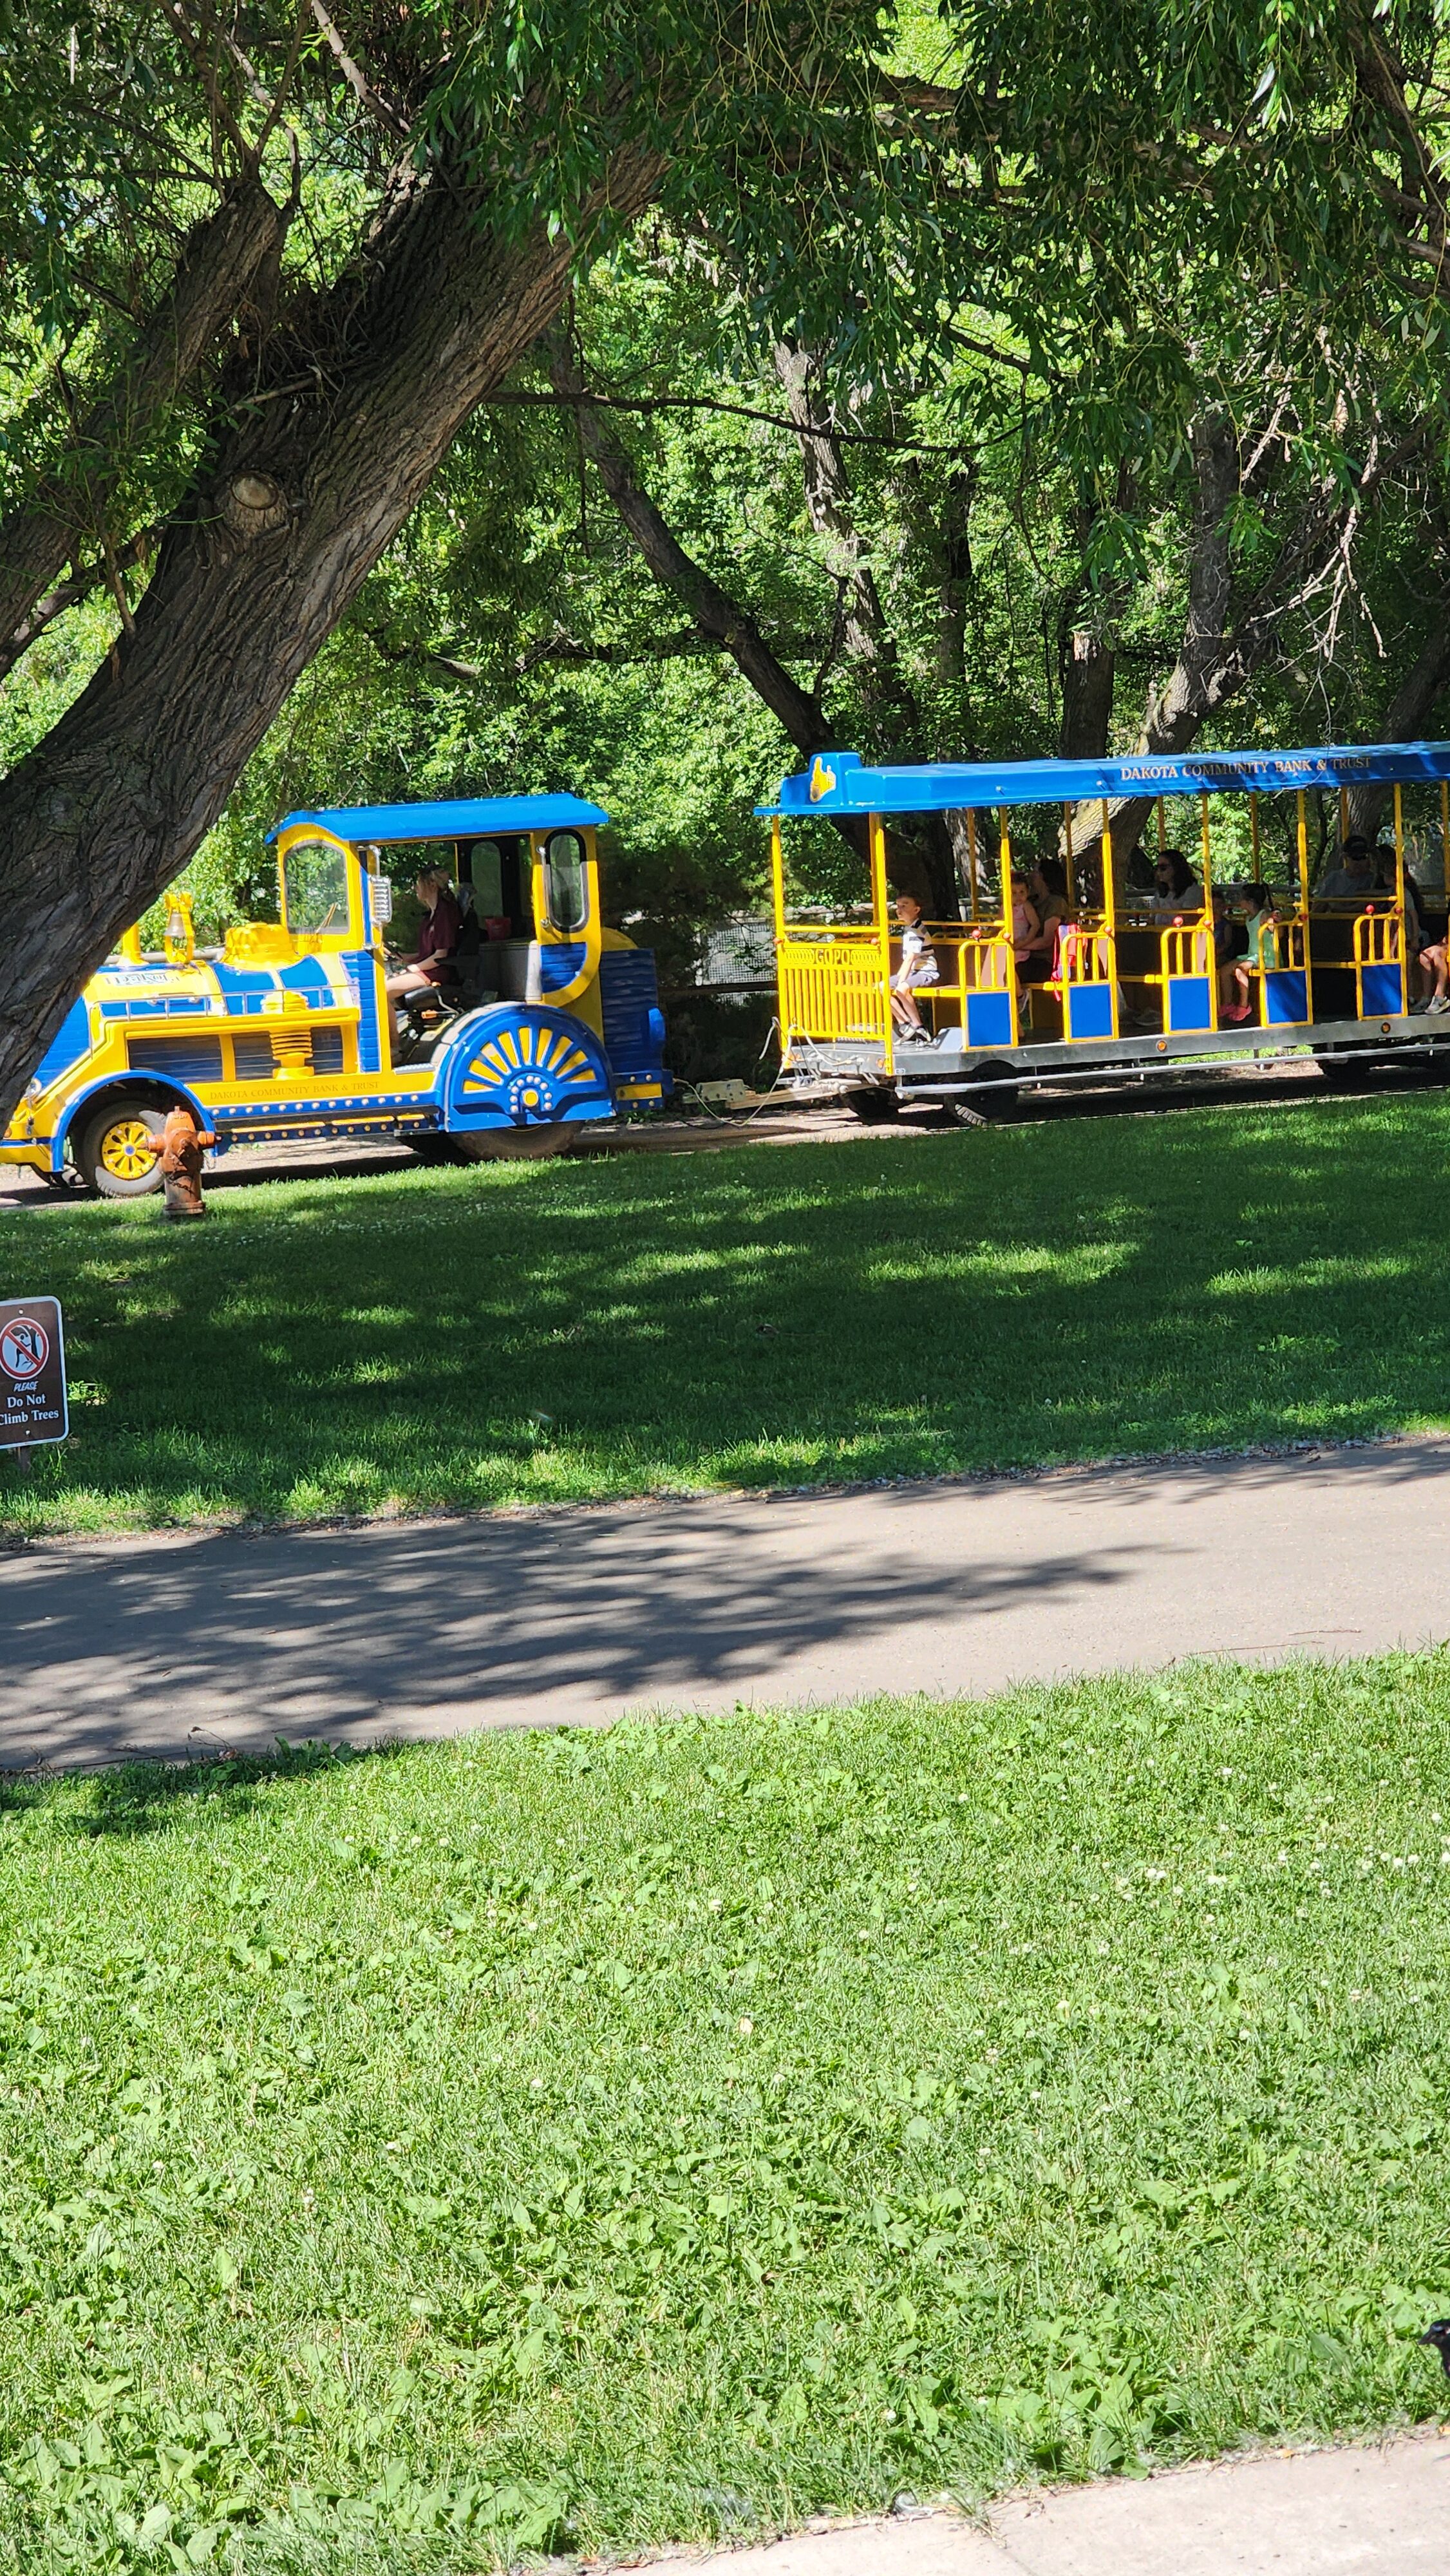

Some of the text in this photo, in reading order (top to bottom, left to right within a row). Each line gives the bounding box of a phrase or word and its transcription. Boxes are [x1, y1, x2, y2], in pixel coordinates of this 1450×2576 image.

[1120, 757, 1371, 781] DAKOTA COMMUNITY BANK & TRUST
[210, 1090, 248, 1100] DAKOTA
[250, 1086, 310, 1097] COMMUNITY
[314, 1084, 339, 1093] BANK
[351, 1081, 380, 1090] TRUST
[14, 1381, 39, 1392] PLEASE
[7, 1394, 46, 1408] Do Not
[0, 1410, 59, 1425] Climb Trees
